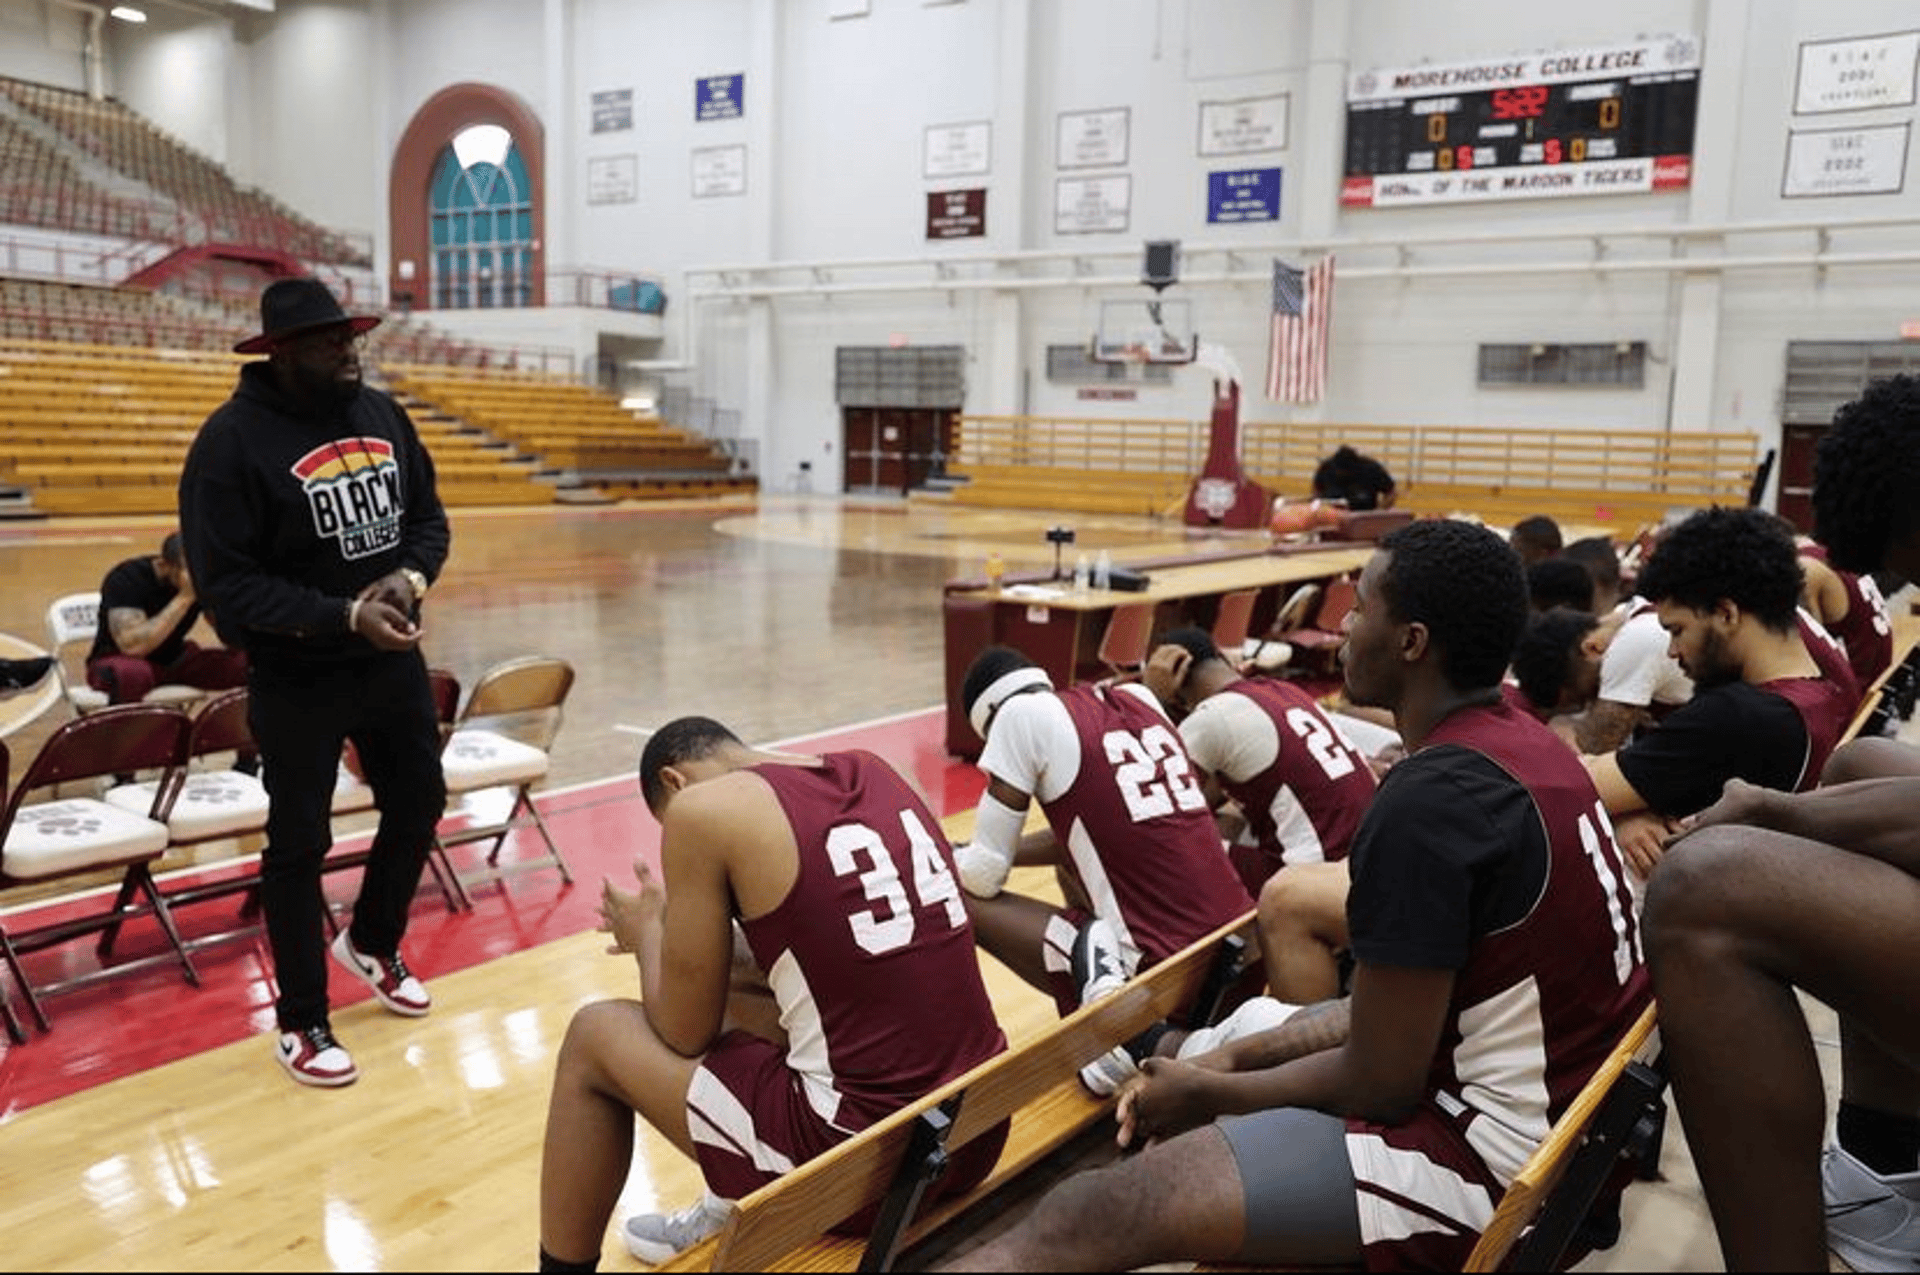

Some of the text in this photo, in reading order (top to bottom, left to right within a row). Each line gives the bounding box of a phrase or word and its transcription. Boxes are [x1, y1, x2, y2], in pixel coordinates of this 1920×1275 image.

[1392, 48, 1648, 88] MOREHOUSE COLLEGE
[1432, 179, 1450, 195] OF
[1461, 178, 1490, 194] THE
[1502, 173, 1574, 190] MAROON
[1583, 167, 1645, 185] TIGERS
[312, 470, 401, 534] BLACK
[1102, 724, 1207, 823] 22
[825, 808, 968, 955] 34
